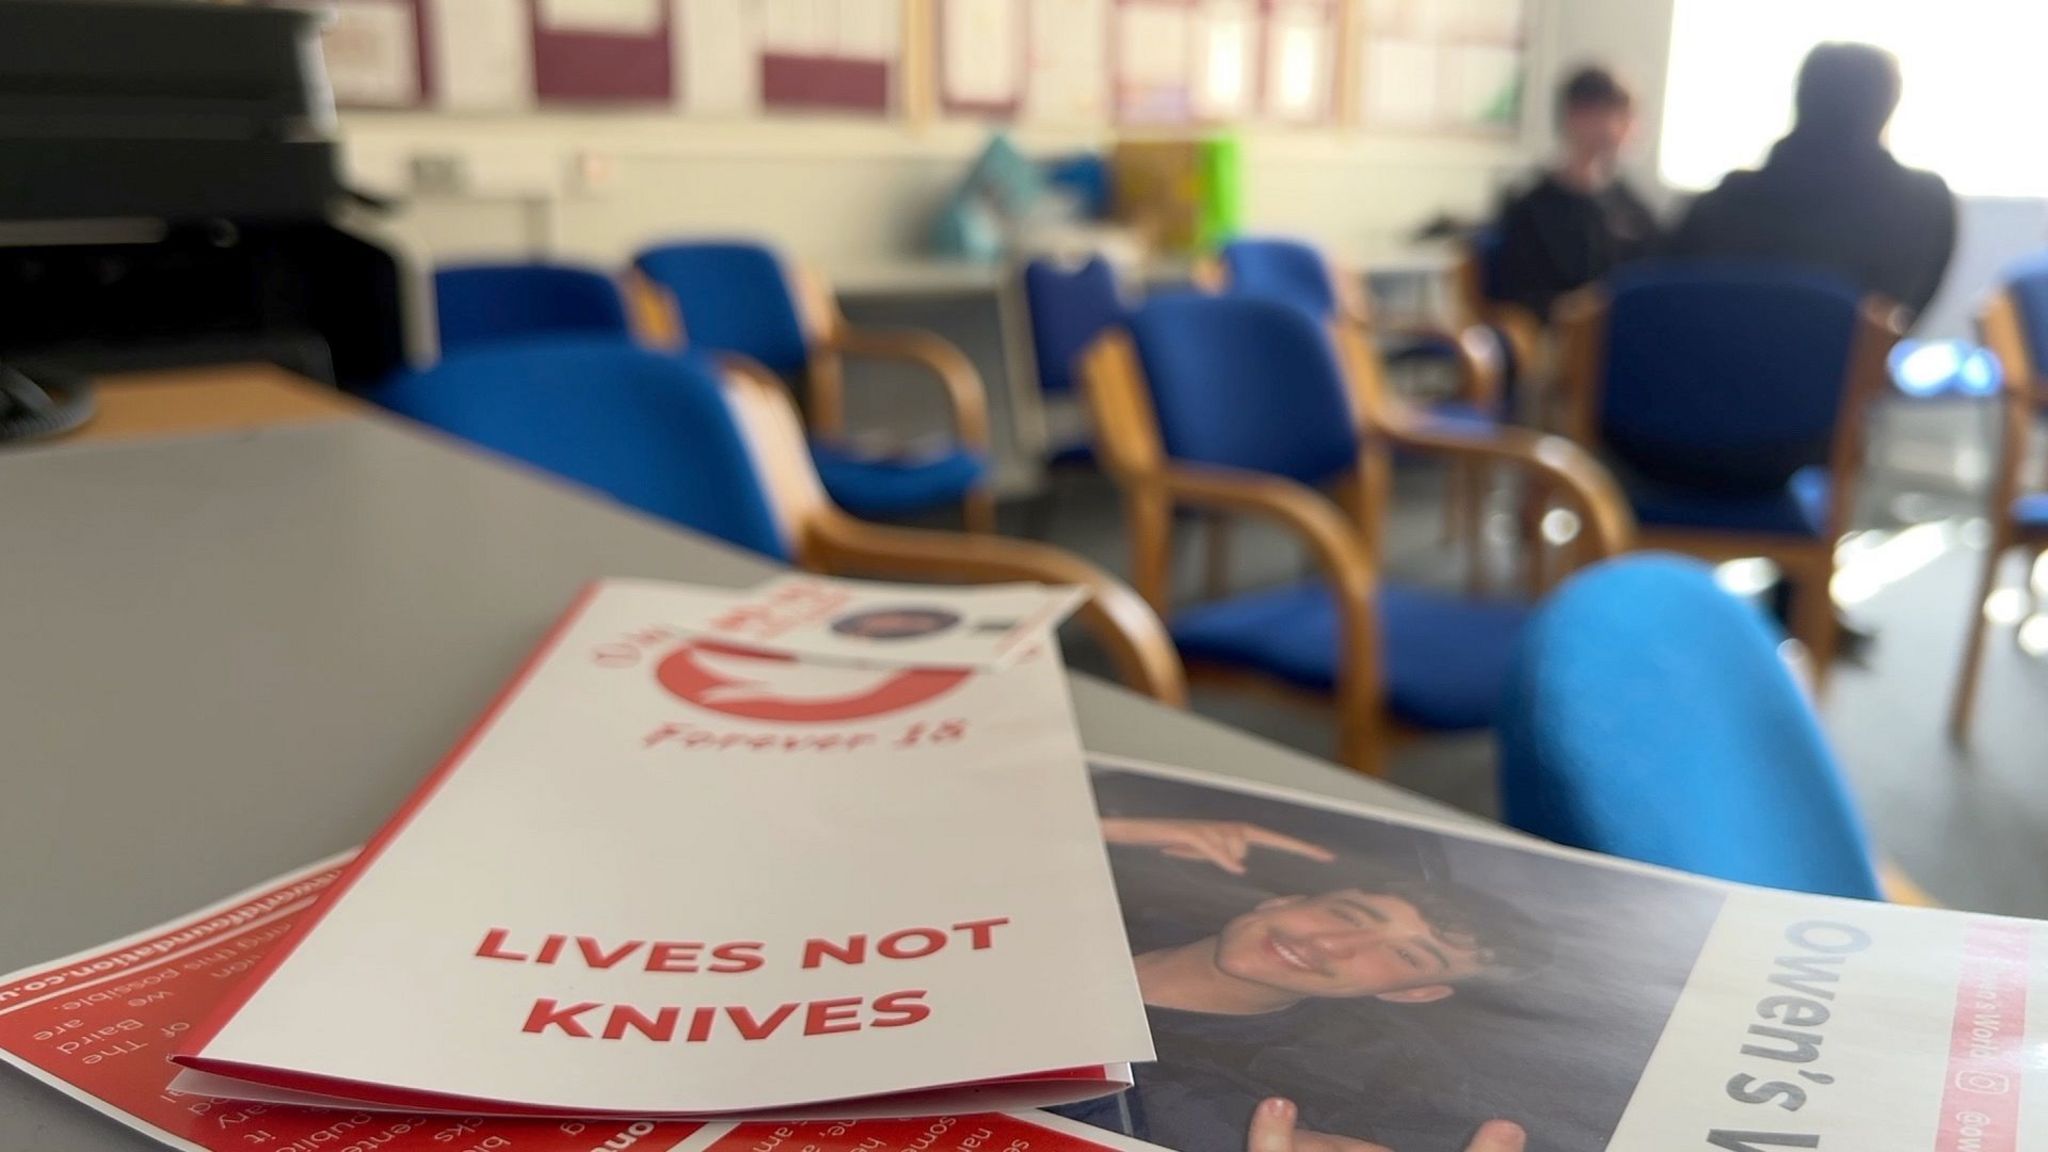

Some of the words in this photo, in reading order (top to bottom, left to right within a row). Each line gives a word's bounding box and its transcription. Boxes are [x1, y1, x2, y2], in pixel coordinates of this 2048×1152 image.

[474, 927, 766, 973] LIVES
[802, 917, 1009, 969] NOT
[53, 967, 181, 1011] possible.
[128, 990, 174, 1007] we
[32, 1018, 85, 1041] are
[160, 1021, 190, 1038] of
[520, 989, 931, 1042] KNIVES
[1725, 920, 1871, 1112] Owen's
[56, 1018, 145, 1054] Baird
[82, 1040, 148, 1065] The
